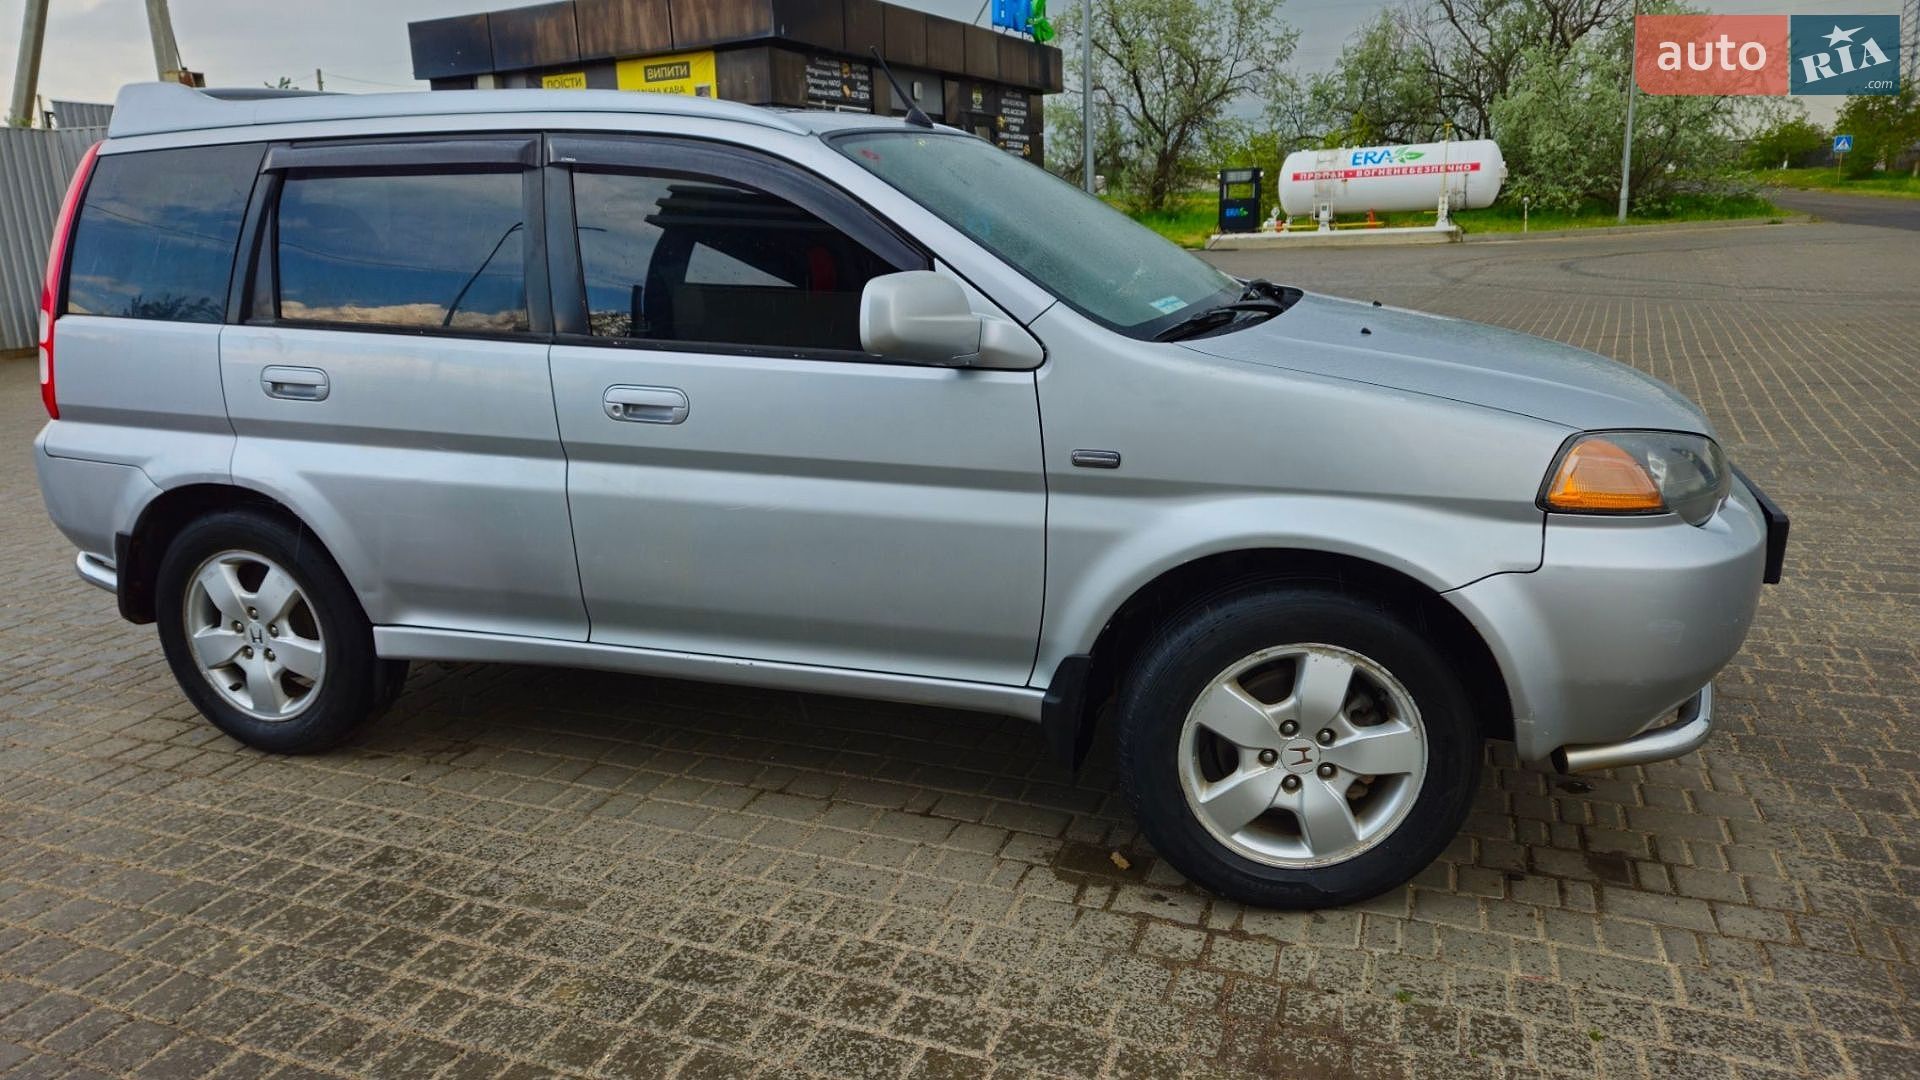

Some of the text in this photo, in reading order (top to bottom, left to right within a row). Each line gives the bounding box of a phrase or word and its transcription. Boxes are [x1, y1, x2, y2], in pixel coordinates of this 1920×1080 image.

[646, 64, 688, 80] ВИПИТИ
[546, 74, 582, 88] ПОЇСТИ
[1351, 149, 1393, 167] ERA
[1300, 170, 1345, 181] ПРОПАН
[1356, 163, 1471, 178] ВОГНЕНЕБЕЗПЕЧНО
